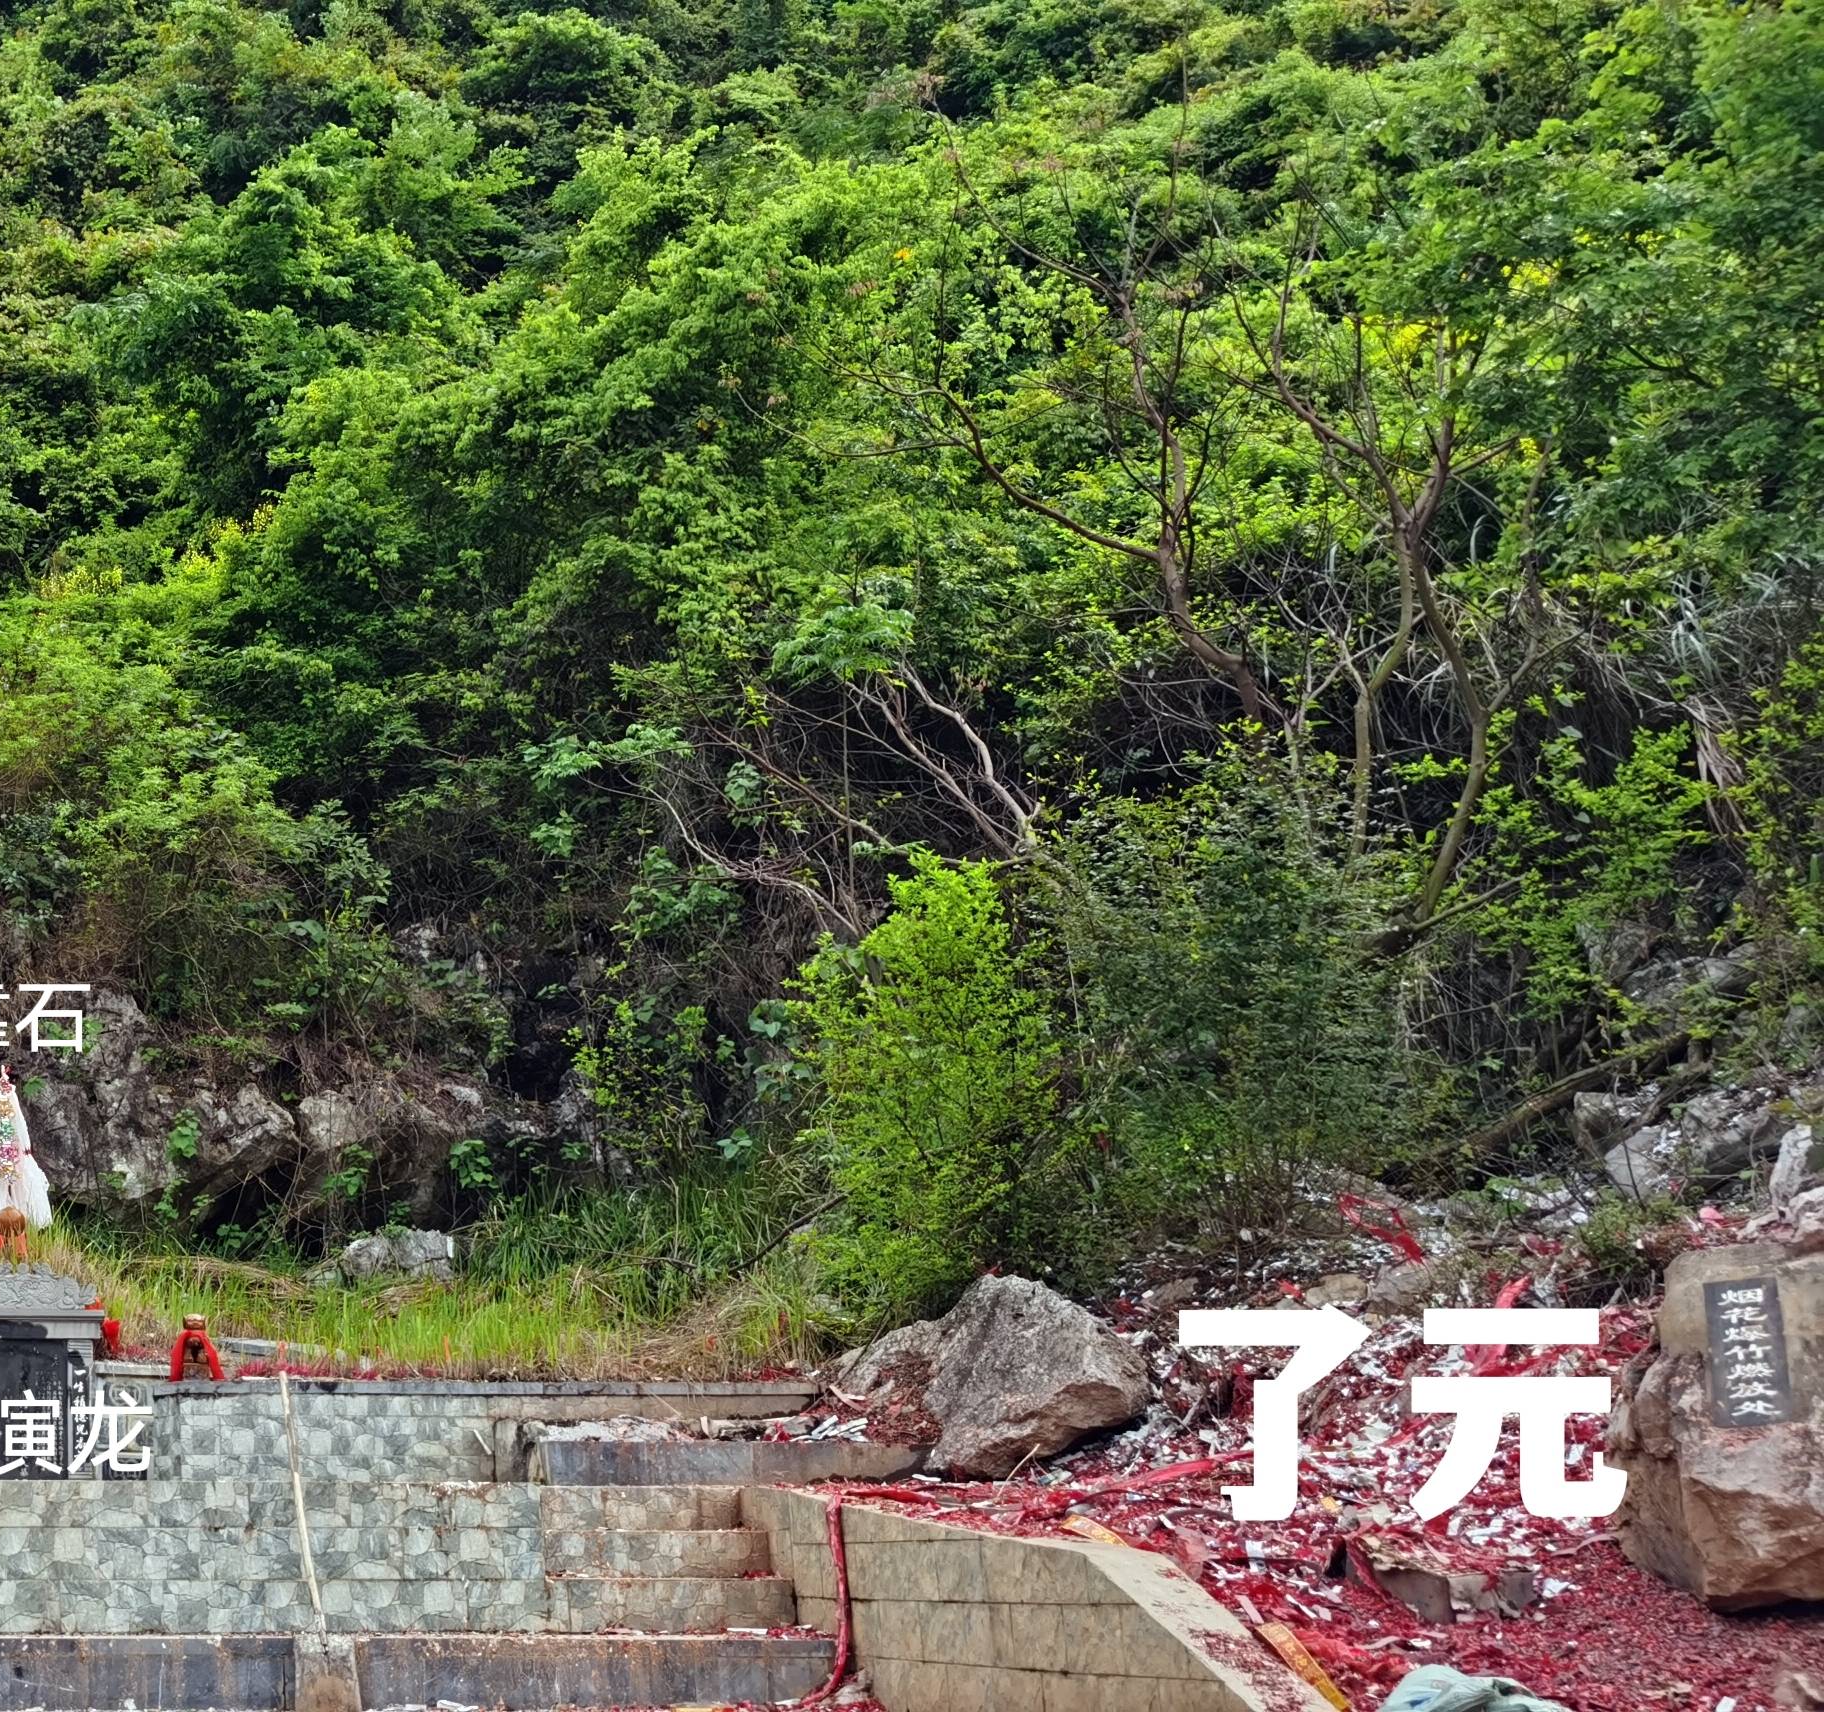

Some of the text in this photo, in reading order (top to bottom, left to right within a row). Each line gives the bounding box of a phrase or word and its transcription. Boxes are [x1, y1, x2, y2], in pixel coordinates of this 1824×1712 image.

[1717, 1287, 1782, 1417] 烟花爆竹燃放处
